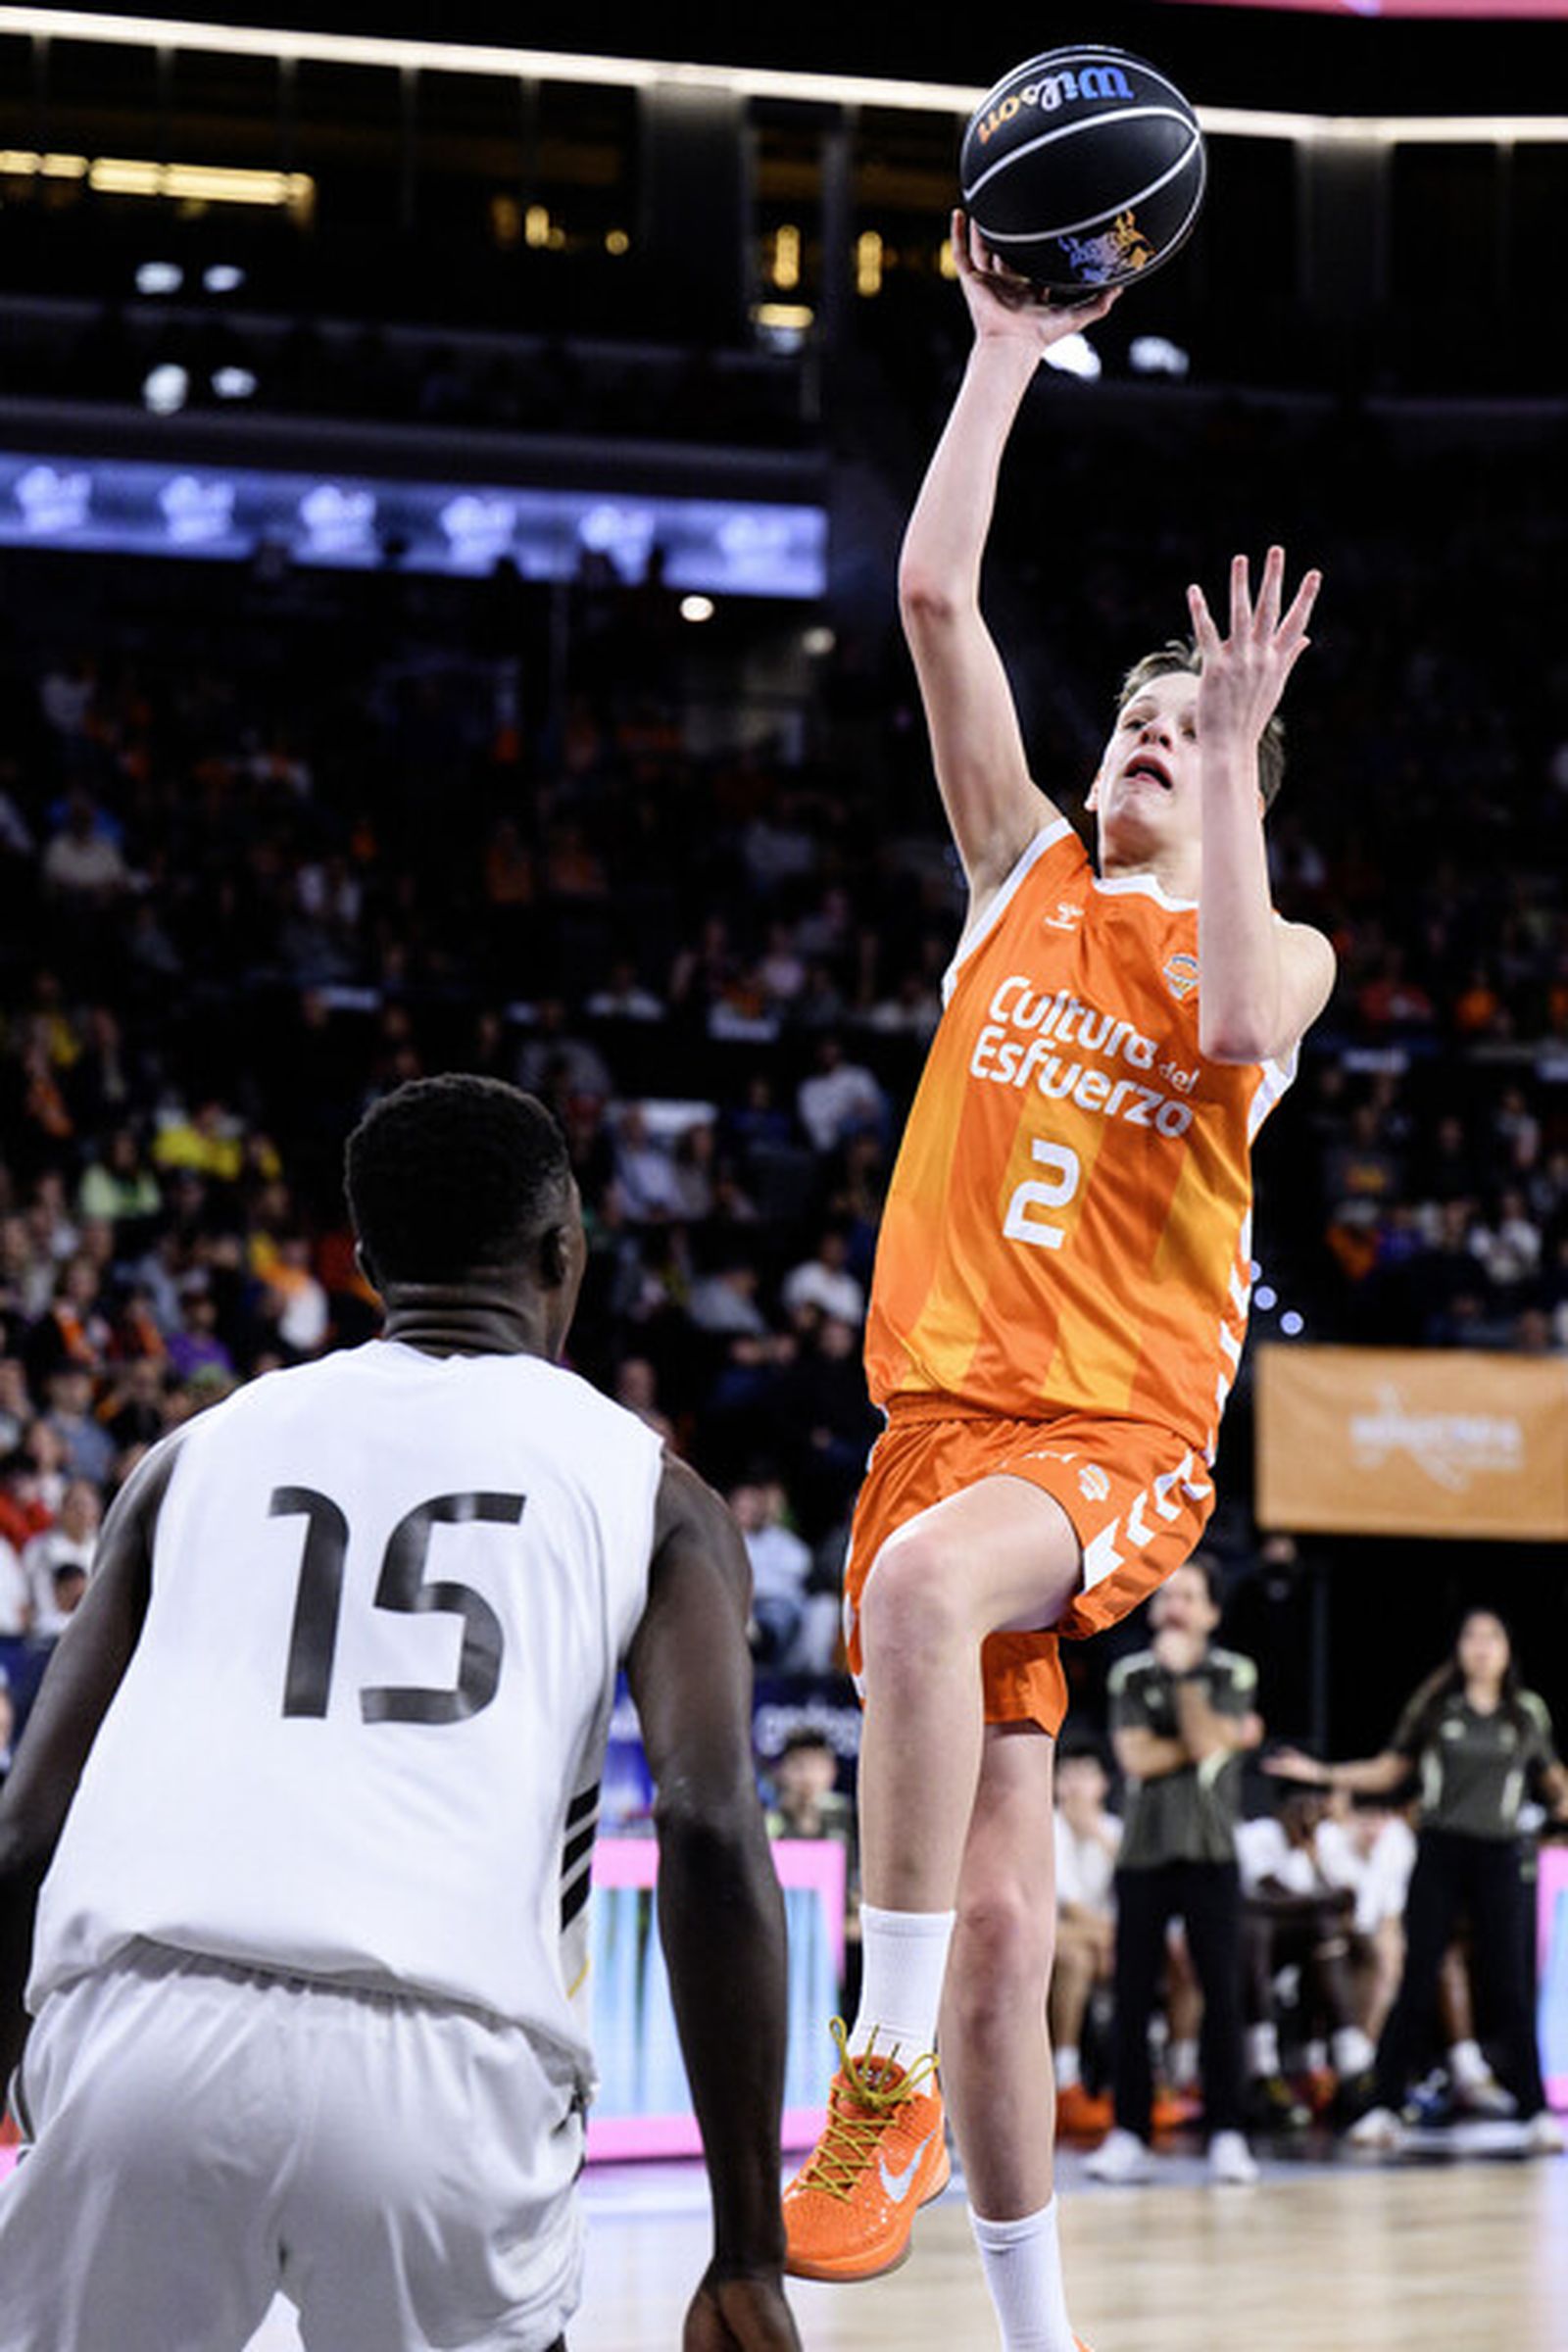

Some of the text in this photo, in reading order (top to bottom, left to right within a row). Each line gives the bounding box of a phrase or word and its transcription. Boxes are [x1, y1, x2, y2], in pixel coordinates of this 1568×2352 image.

[978, 65, 1135, 144] Wilson
[969, 1025, 1194, 1138] Esfuerzo
[989, 975, 1200, 1095] Cultura del
[1002, 1138, 1081, 1250] 2
[268, 1485, 527, 1726] 15
